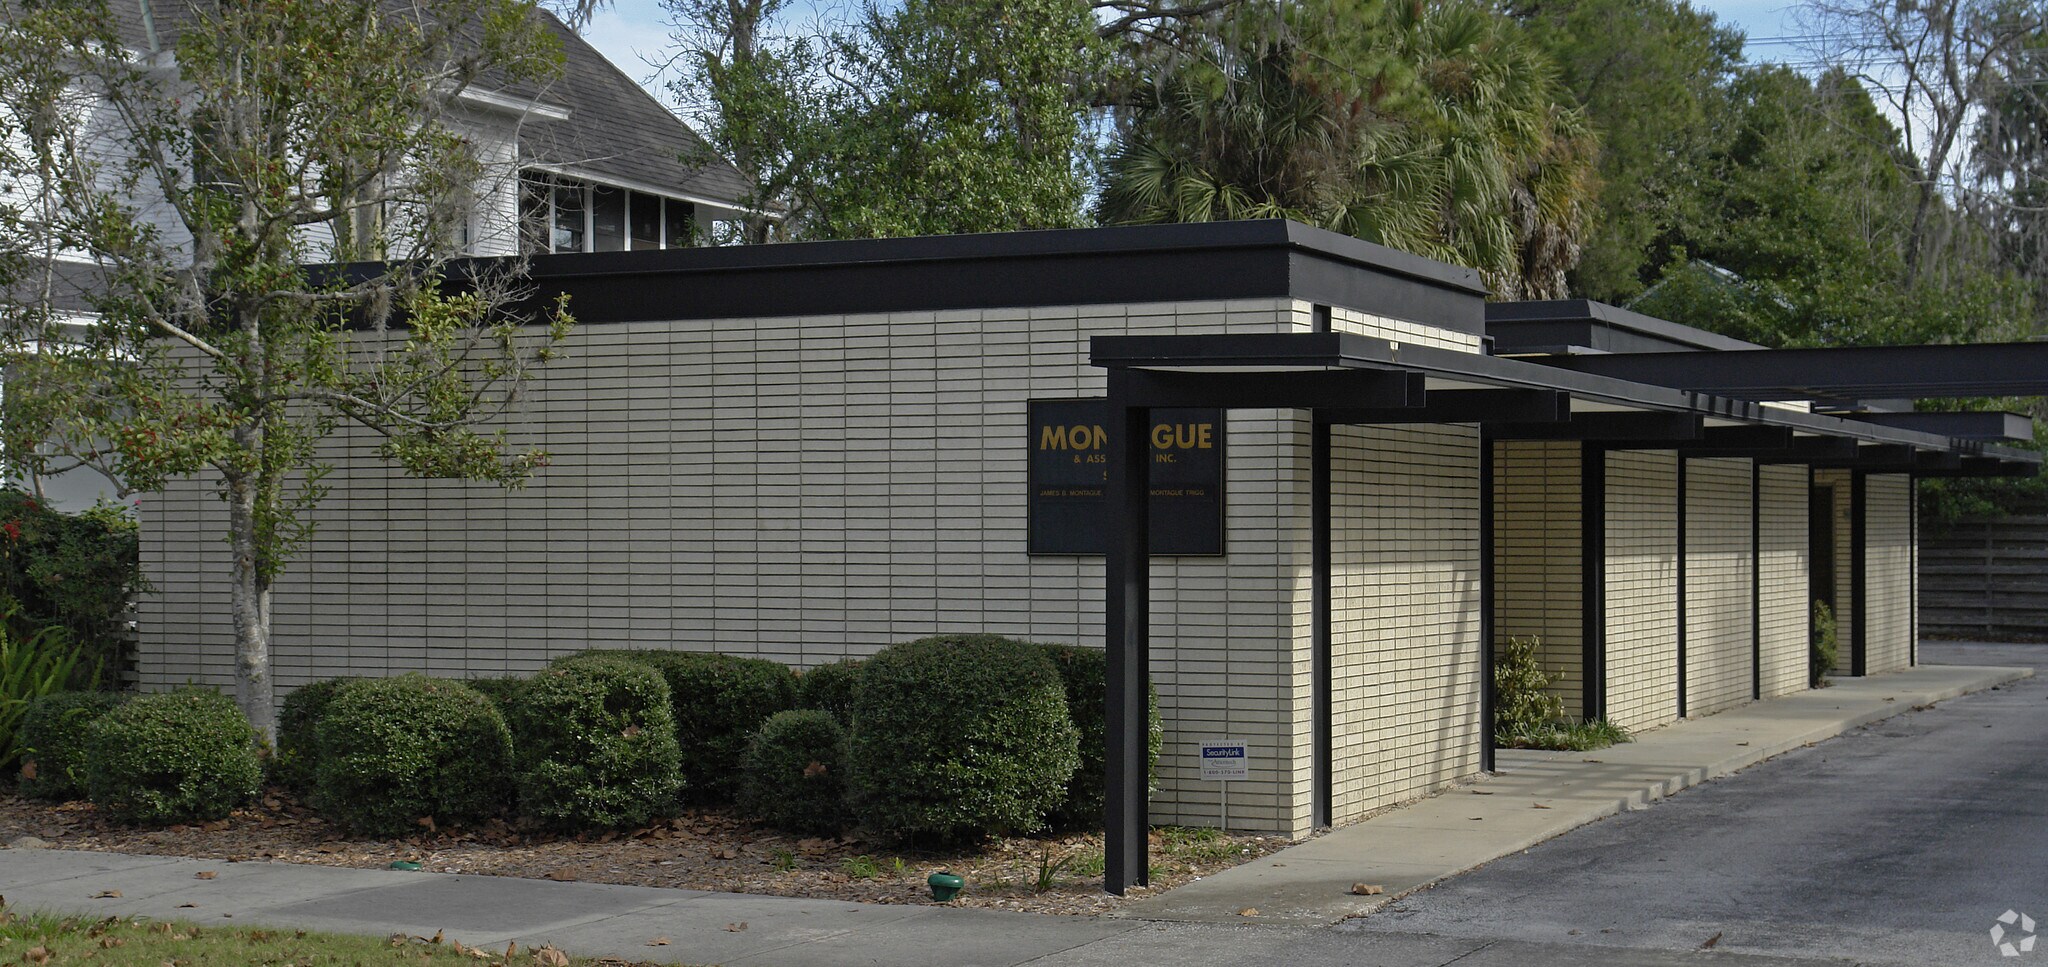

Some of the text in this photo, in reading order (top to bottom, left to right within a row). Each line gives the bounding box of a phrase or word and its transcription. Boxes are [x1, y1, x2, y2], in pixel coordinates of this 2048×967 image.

[1040, 424, 1212, 450] MONGUE
[1073, 454, 1081, 464] &
[1155, 453, 1177, 463] INC.
[1206, 748, 1240, 758] SecurityLink
